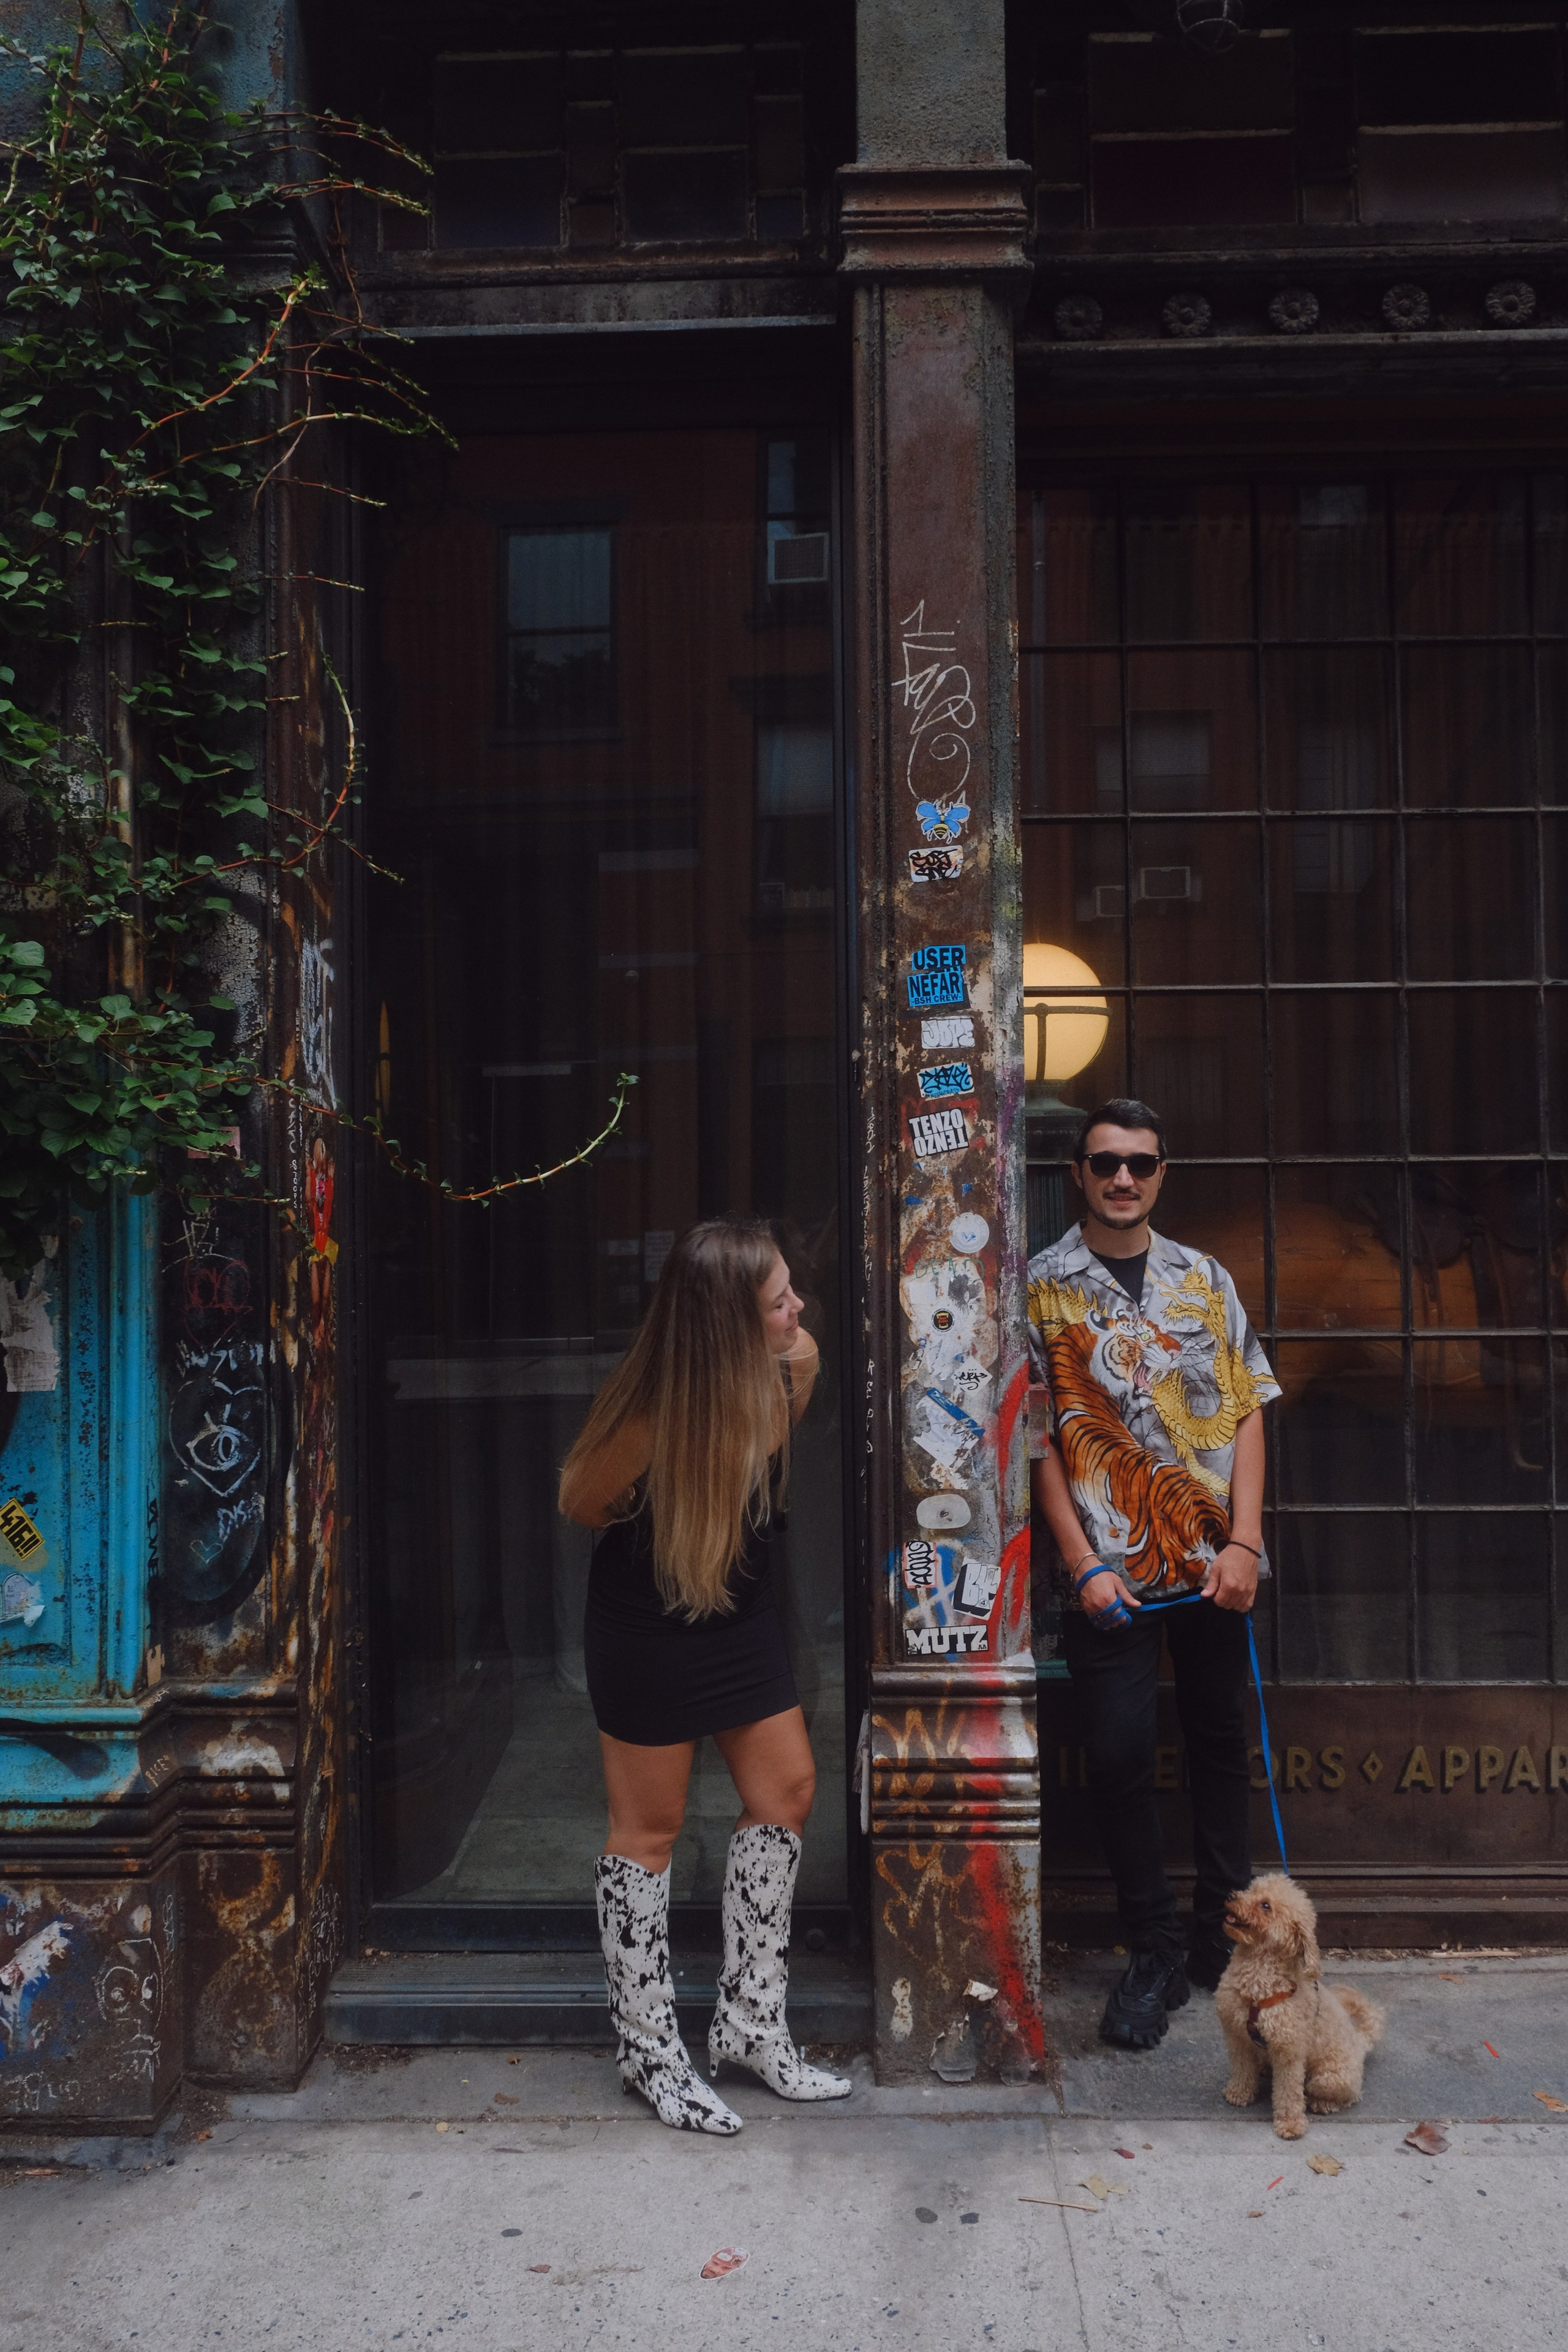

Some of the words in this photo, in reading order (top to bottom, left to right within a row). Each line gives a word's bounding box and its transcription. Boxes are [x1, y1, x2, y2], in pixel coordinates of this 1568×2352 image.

[913, 948, 963, 970] USER
[910, 973, 960, 998] NEFAR
[909, 1109, 963, 1137] TENZO
[907, 1625, 988, 1654] MUTZ
